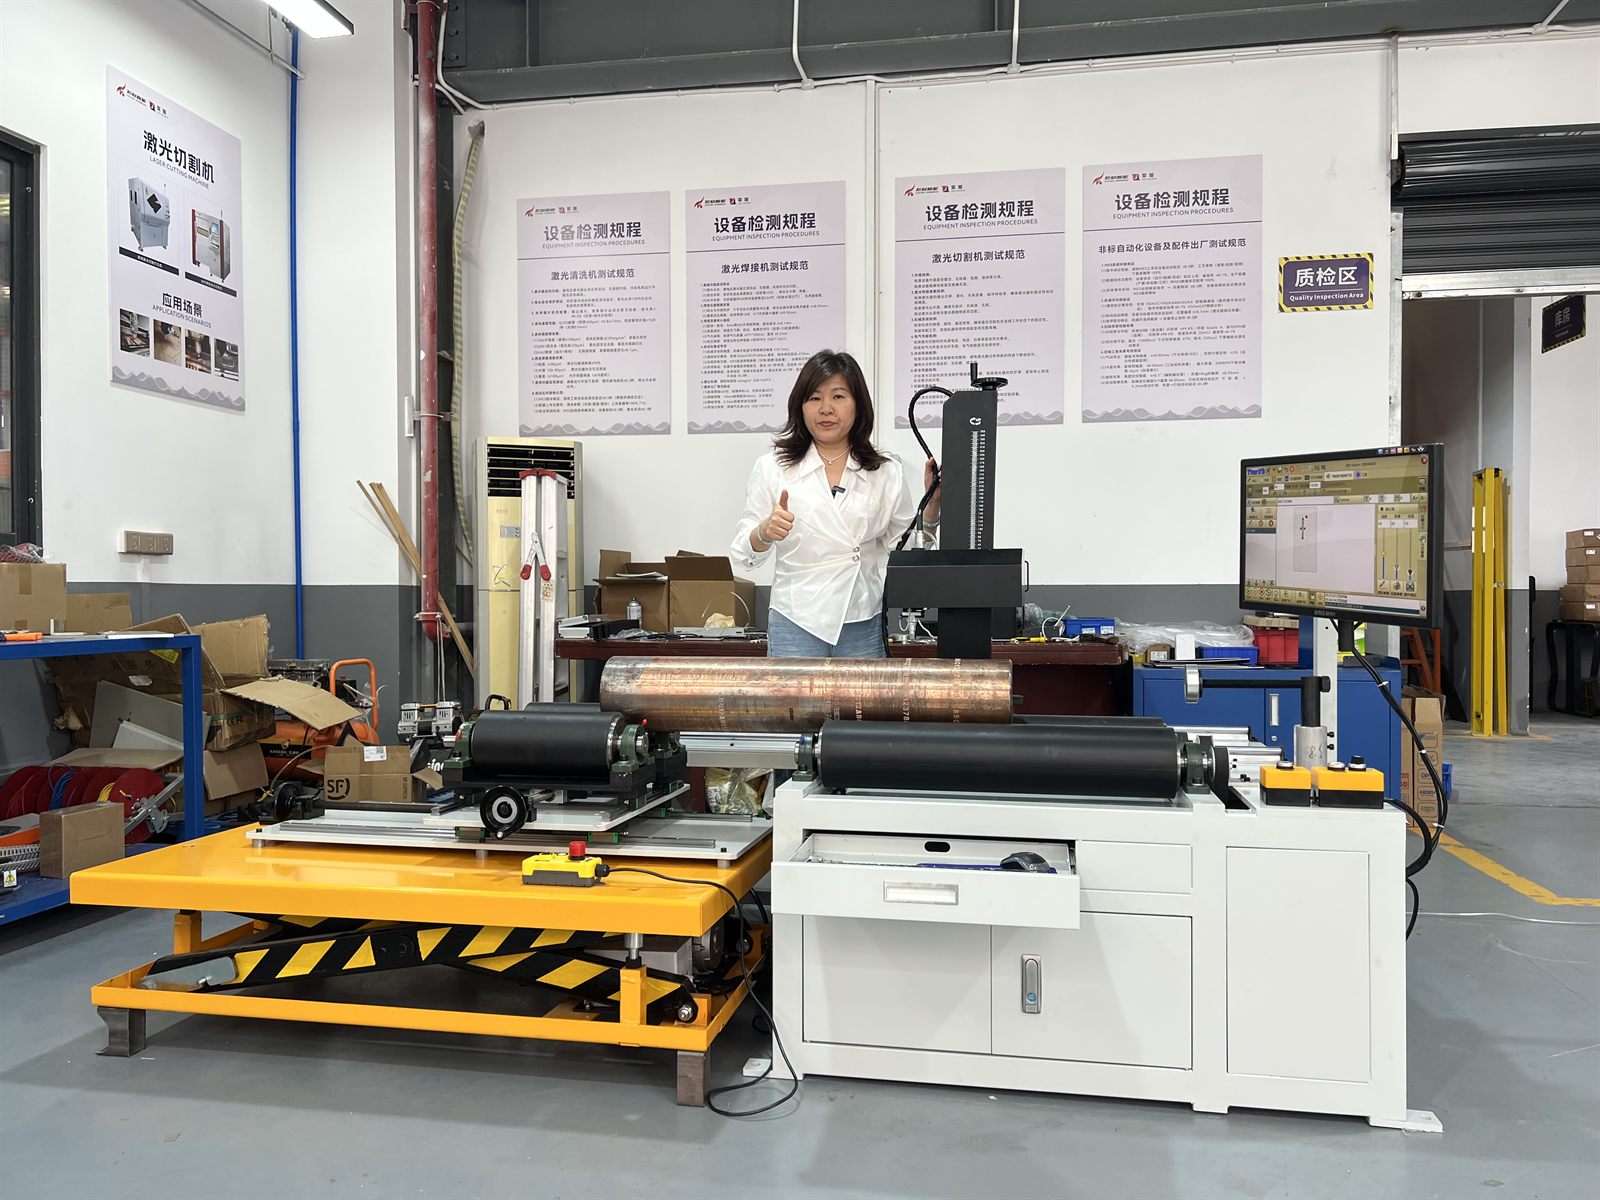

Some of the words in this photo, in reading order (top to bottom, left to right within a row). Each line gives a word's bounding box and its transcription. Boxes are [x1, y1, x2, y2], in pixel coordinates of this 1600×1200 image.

[143, 130, 214, 183] 激光切割机
[149, 155, 165, 168] LASER
[166, 163, 187, 179] CUTTING
[188, 174, 210, 189] MACHINE
[1114, 188, 1230, 211] 设备检测规程
[925, 200, 1034, 222] 设备检测规程
[1112, 211, 1150, 220] EQUIPMENT
[1151, 209, 1190, 217] INSPECTION
[1190, 207, 1234, 215] PROCEDURES
[544, 221, 642, 242] 设备检测规程
[714, 212, 816, 234] 设备检测规程
[923, 222, 959, 230] EQUIPMENT
[997, 218, 1038, 226] PROCEDURES
[542, 242, 574, 250] EQUIPMENT
[712, 234, 745, 242] EQUIPMENT
[781, 230, 820, 238] PROCEDURES
[1098, 238, 1246, 254] 非标自动化设备及配件出厂测试规范
[721, 260, 809, 274] 激光焊接机测试规范
[932, 249, 1026, 264] 激光切割机测试规范
[550, 268, 635, 281] 激光清洗机测试规范
[1294, 266, 1358, 288] 质检区
[162, 292, 202, 318] 应用场景
[152, 304, 185, 320] APPLICATION
[185, 316, 212, 329] SCENARIOS
